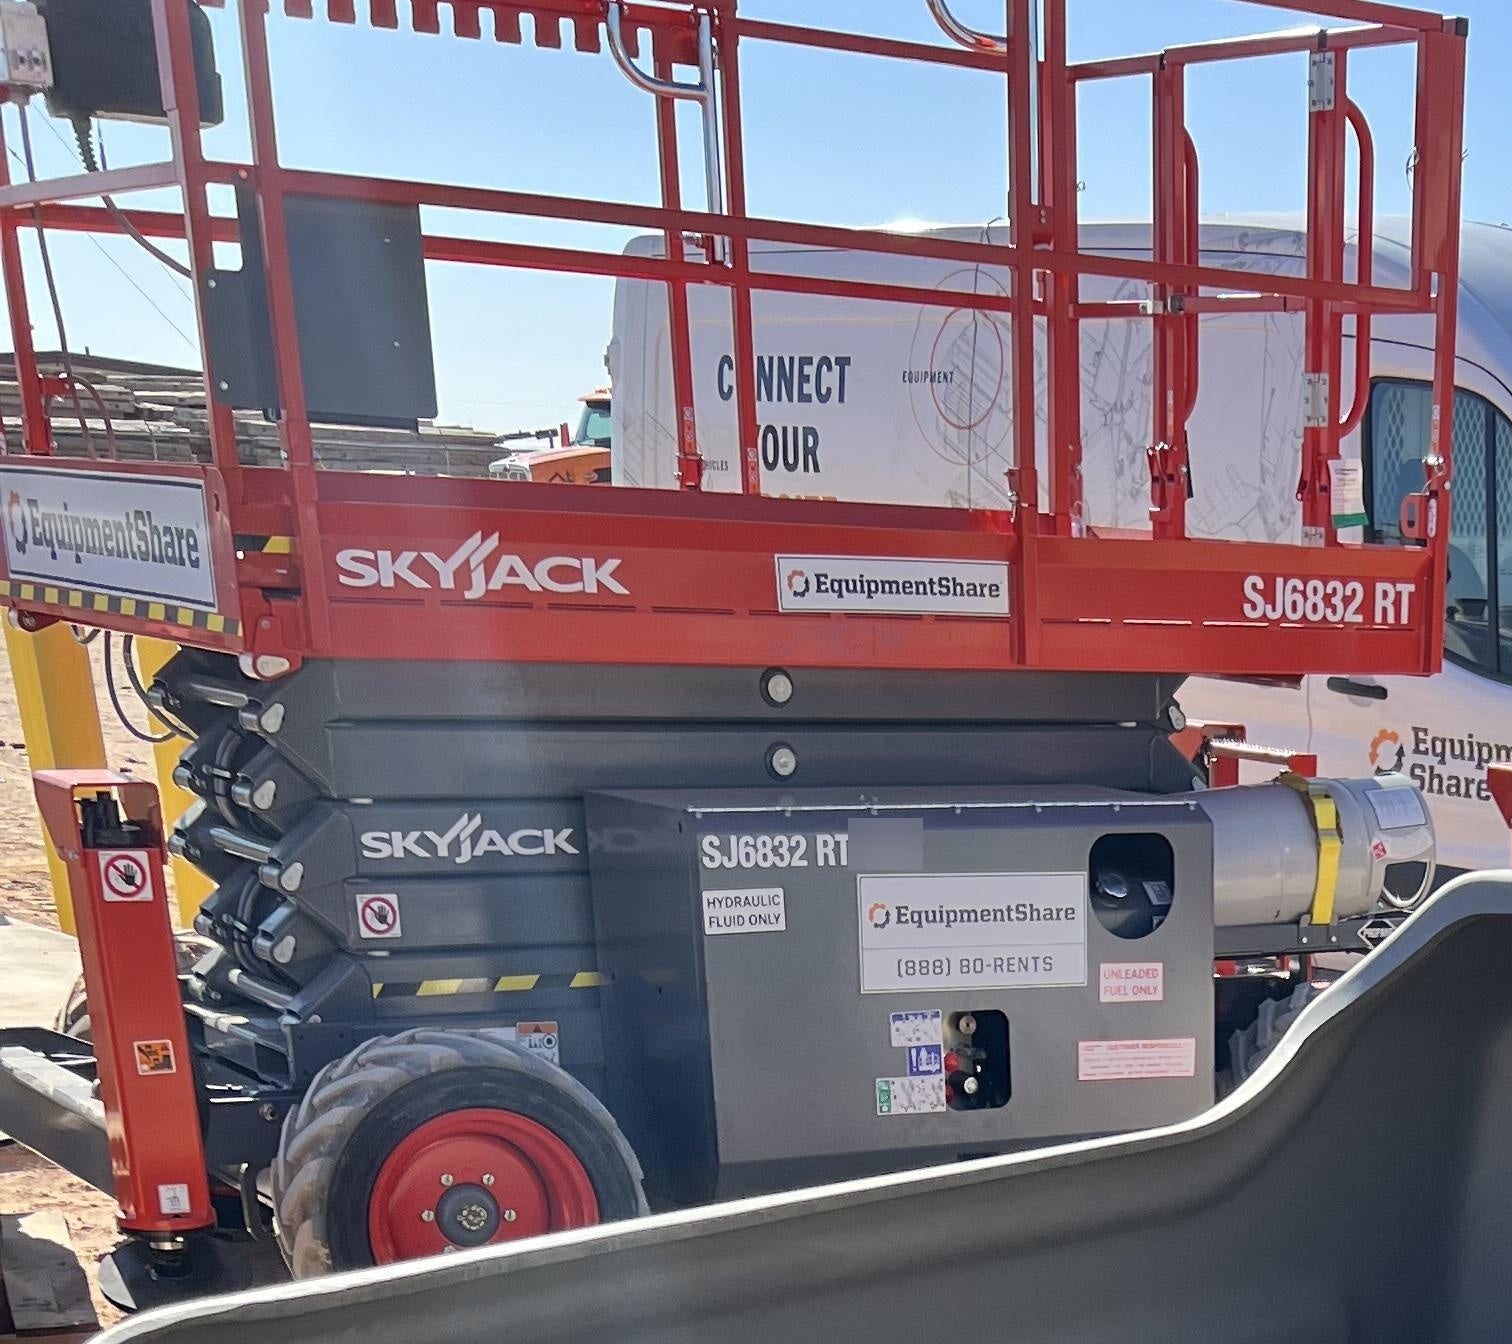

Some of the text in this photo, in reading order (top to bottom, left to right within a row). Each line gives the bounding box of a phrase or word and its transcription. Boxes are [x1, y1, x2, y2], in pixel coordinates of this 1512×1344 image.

[717, 354, 852, 404] CNNECT
[902, 370, 955, 384] EQUIPMENT
[27, 497, 200, 569] EquipmentShare
[335, 530, 630, 600] SKYJACK
[814, 572, 1000, 600] EquipmentShare
[1243, 574, 1416, 625] SJ6832 RT
[1410, 763, 1491, 801] Share
[359, 812, 579, 864] SKYJACK
[701, 834, 848, 869] SJ6832 RT
[706, 893, 781, 909] HYDRAULIC
[708, 912, 781, 929] FLUID ONLY
[895, 903, 1076, 928] EquipmentShare
[897, 957, 951, 978] (888)
[1103, 968, 1160, 980] UNLEADED
[1103, 983, 1159, 997] FUEL ONLY
